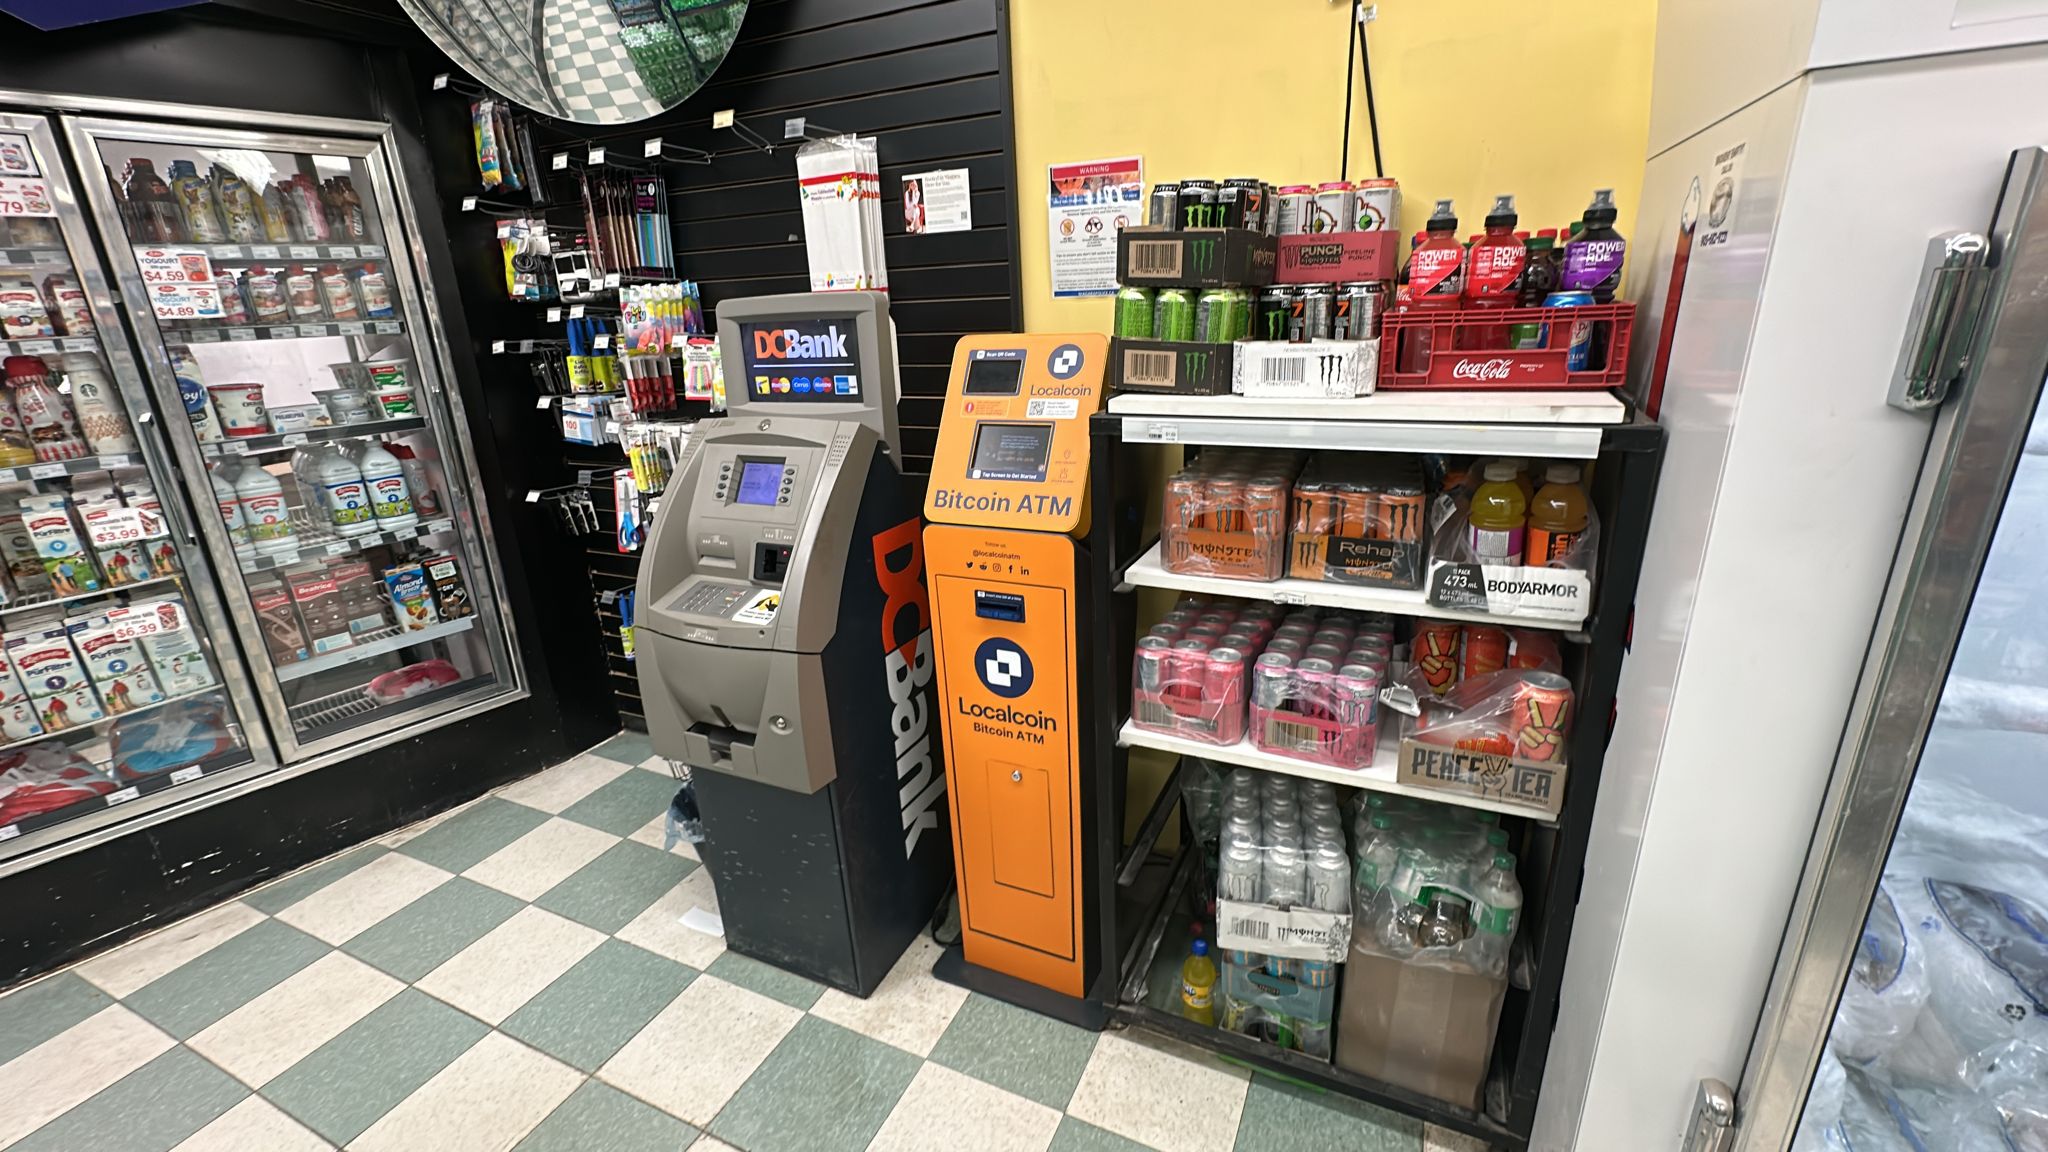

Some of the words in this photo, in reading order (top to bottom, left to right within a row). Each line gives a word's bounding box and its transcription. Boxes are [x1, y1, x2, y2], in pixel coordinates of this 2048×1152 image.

[1080, 166, 1109, 174] WARNING
[1301, 246, 1342, 256] PUNCH
[1418, 250, 1457, 260] POWER
[144, 270, 184, 281] $4.59
[158, 307, 194, 316] $4.89
[754, 326, 848, 358] DCBank
[1030, 384, 1092, 396] Localcoin
[566, 420, 577, 430] 100
[934, 490, 1010, 512] Bitcoin
[1016, 494, 1072, 516] ATM
[96, 528, 139, 542] $3.99
[972, 550, 1020, 560] @localcoinatm
[1193, 544, 1262, 558] MONSTER
[1340, 542, 1404, 558] Rehab
[299, 582, 332, 594] Beatrice
[394, 576, 424, 594] Almond
[1444, 576, 1468, 588] 473
[1488, 580, 1578, 598] BODYARMOR
[116, 623, 156, 638] $6.39
[112, 662, 122, 670] 2
[872, 516, 947, 861] DCBank
[959, 696, 1056, 732] Localcoin
[974, 722, 1014, 740] Bitcoin
[1016, 731, 1044, 744] ATM
[1412, 748, 1483, 786] PEACE
[1510, 764, 1556, 798] TEA
